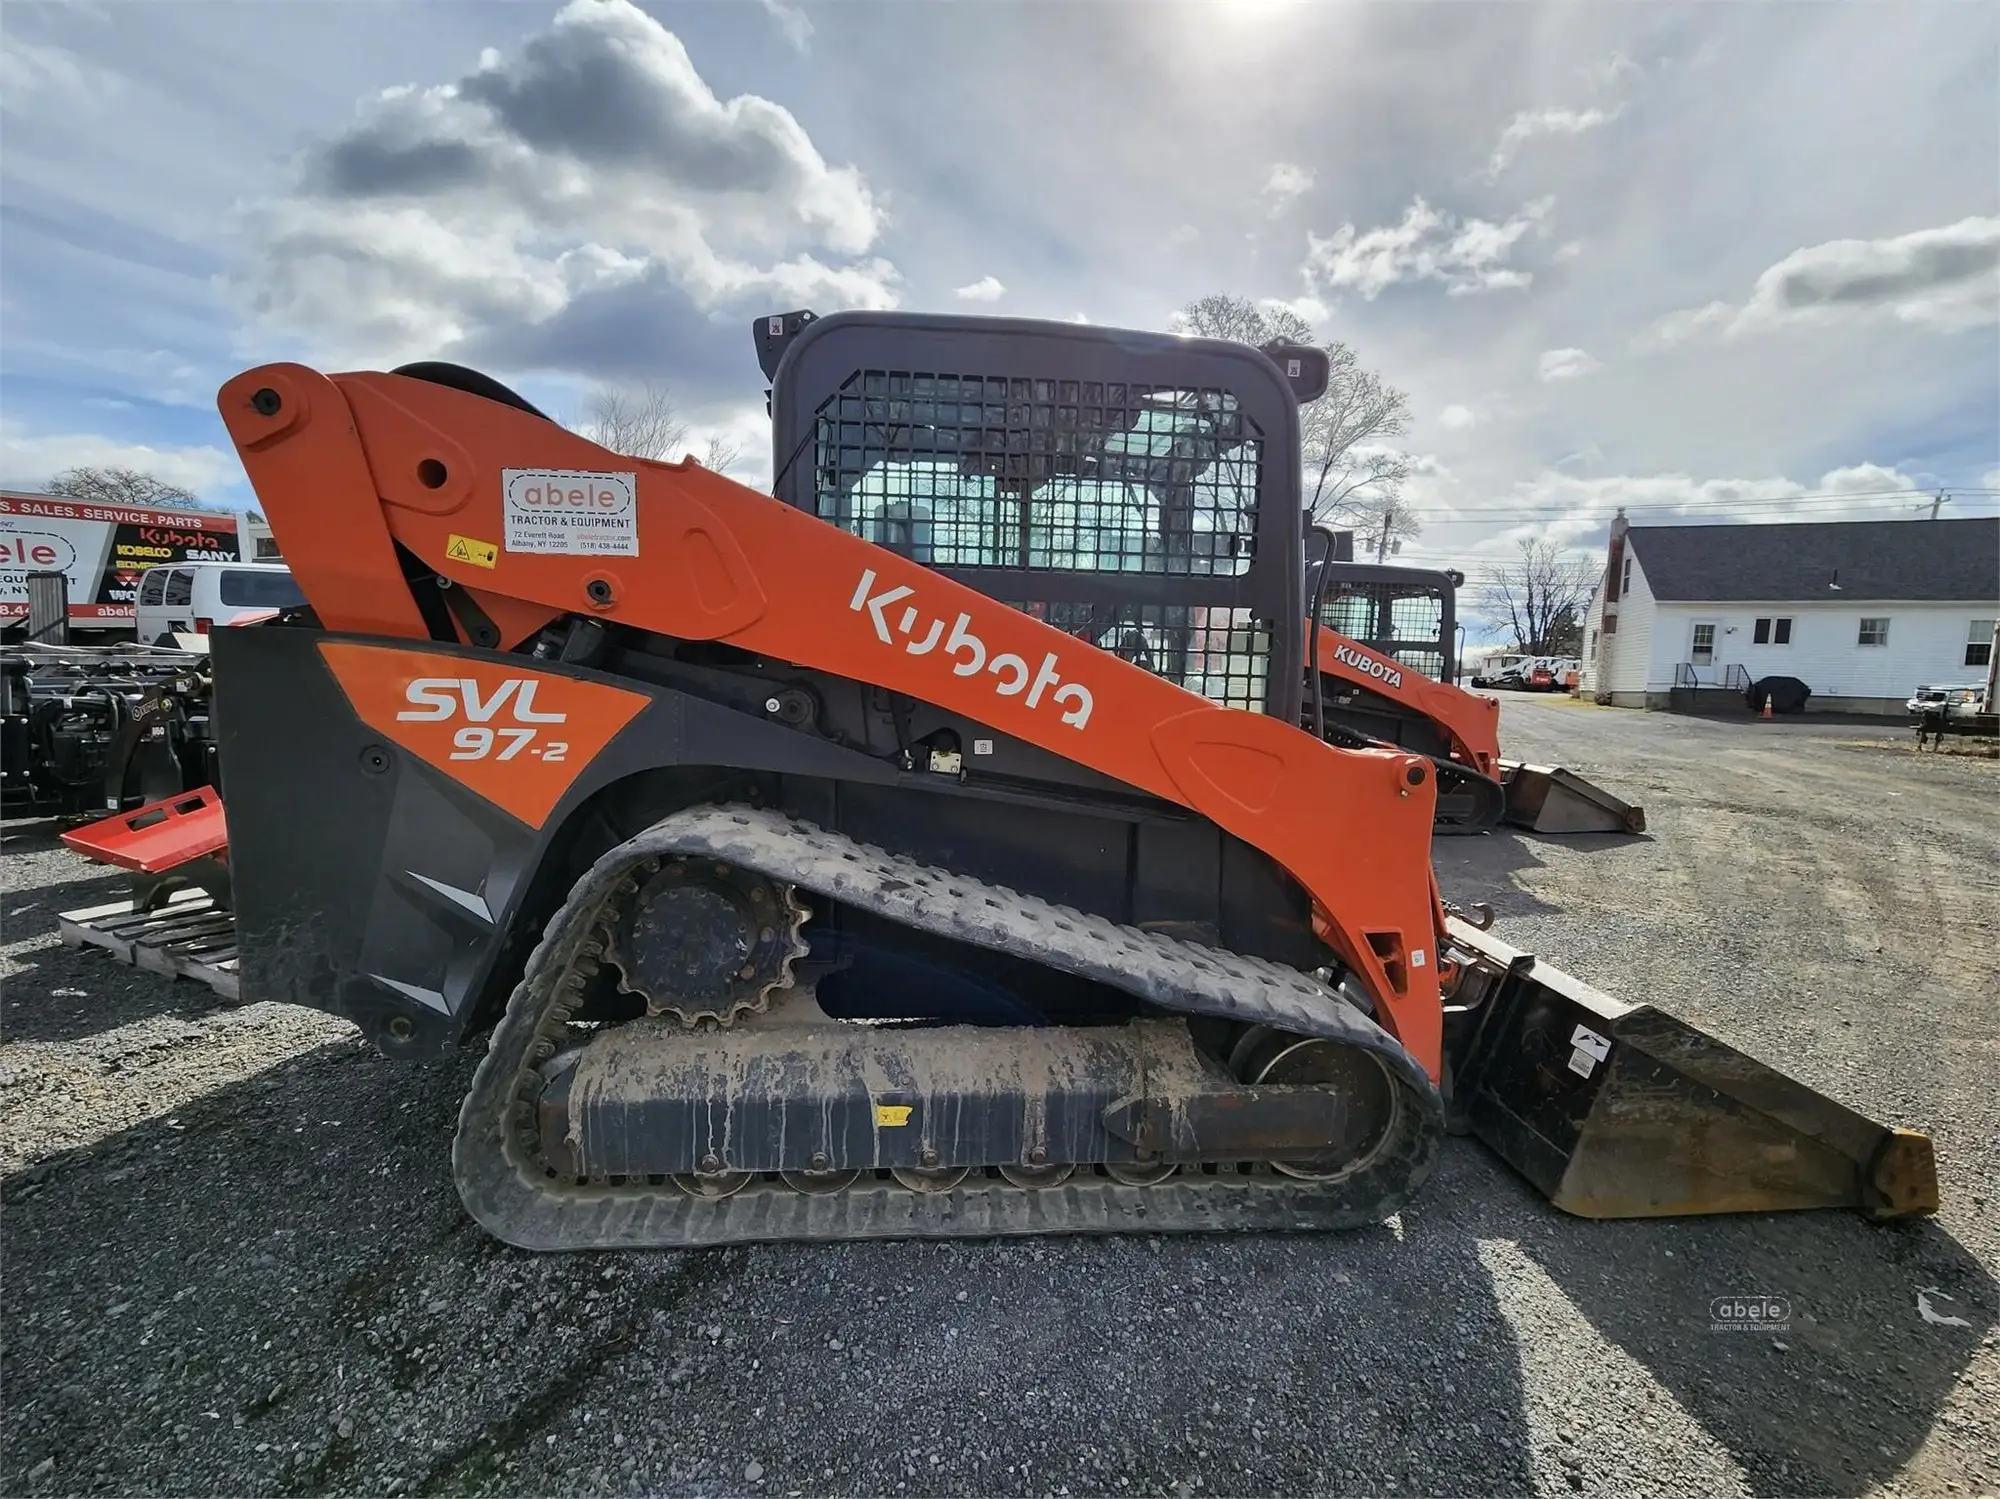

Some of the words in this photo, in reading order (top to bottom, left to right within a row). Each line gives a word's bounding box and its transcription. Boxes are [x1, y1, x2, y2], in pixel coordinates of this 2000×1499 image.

[524, 483, 615, 508] abele
[20, 502, 80, 517] SALES.
[83, 508, 153, 524] SERVICE.
[157, 515, 202, 528] PARTS
[510, 515, 558, 527] TRACTOR
[560, 517, 568, 526] &
[571, 517, 631, 528] EQUIPMENT
[140, 527, 218, 548] Kubota
[511, 540, 536, 548] Albany,
[549, 541, 568, 549] 12205
[523, 531, 547, 539] Everett
[548, 532, 565, 540] Road
[116, 544, 172, 558] KOBELCO
[185, 549, 236, 562] SANY
[850, 568, 1095, 730] Kubota
[1333, 644, 1402, 688] KUBOTA
[396, 678, 567, 723] SVL
[449, 727, 569, 762] 97-2
